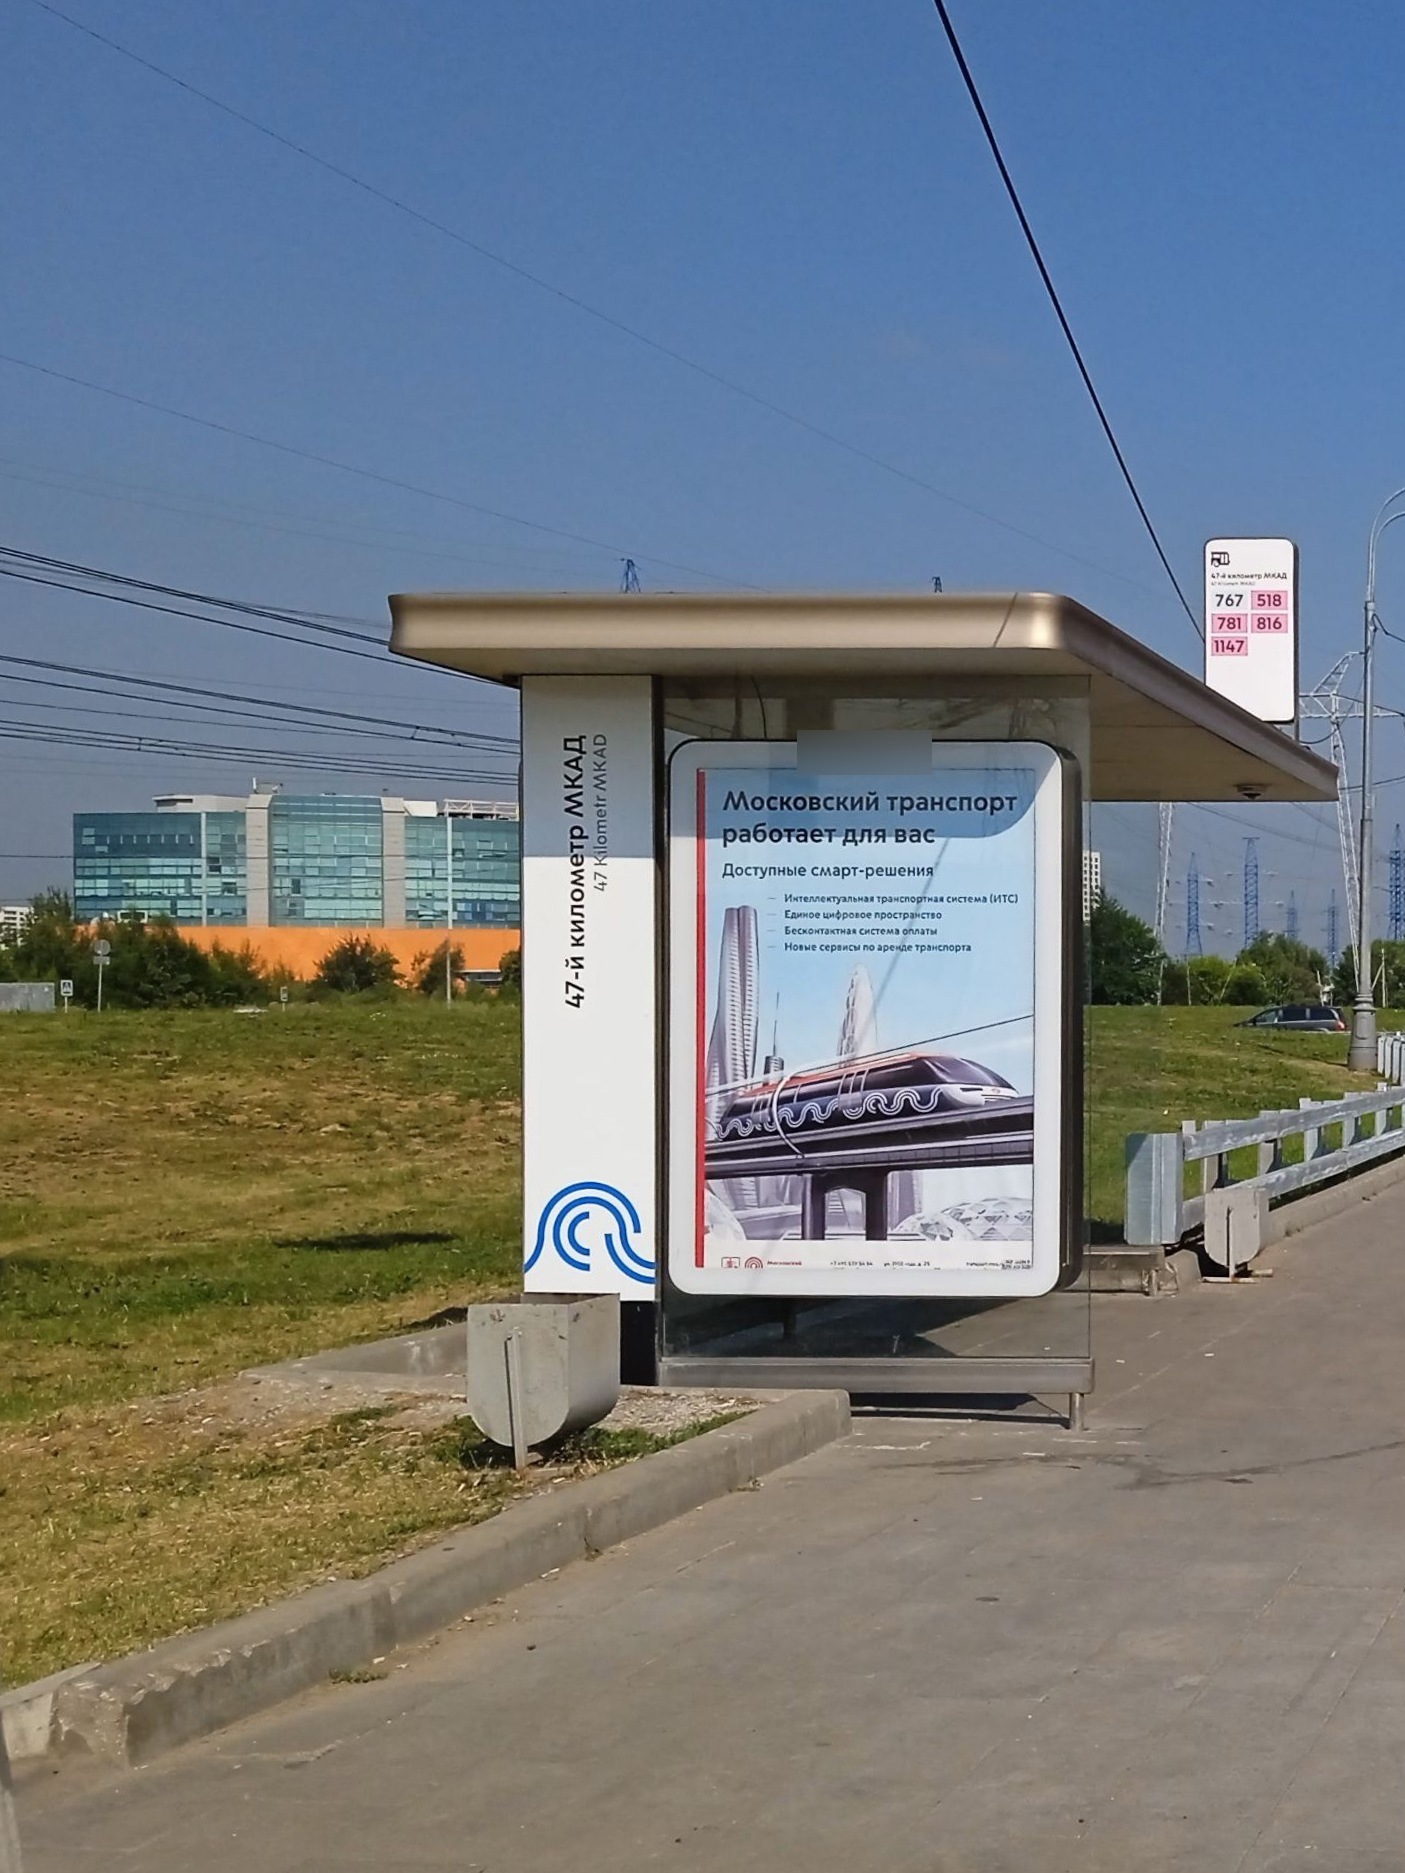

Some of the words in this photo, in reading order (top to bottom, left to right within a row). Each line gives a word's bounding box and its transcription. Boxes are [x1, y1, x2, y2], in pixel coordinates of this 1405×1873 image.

[1263, 572, 1288, 580] МКАД
[1215, 594, 1244, 607] 767
[1257, 594, 1282, 607] 518
[1217, 617, 1242, 630] 781
[1257, 617, 1282, 630] 816
[1214, 640, 1245, 653] 1147
[593, 734, 607, 791] MKAD
[563, 735, 586, 818] МКАД
[722, 791, 879, 811] Московский
[887, 795, 1017, 815] транспорт
[593, 796, 607, 866] Kilometr
[722, 823, 836, 847] работает
[842, 827, 887, 846] для
[894, 827, 936, 843] вас
[722, 863, 807, 879] Доступные
[811, 864, 934, 878] смарт-решения
[569, 825, 588, 947] километр
[593, 872, 607, 891] 47
[784, 894, 875, 905] Интеллектуальная
[876, 895, 945, 905] транспортная
[947, 896, 988, 904] система
[989, 893, 1019, 905] (ИТС)
[784, 909, 821, 920] Единое
[822, 910, 872, 922] цифровое
[874, 911, 943, 921] пространство
[784, 925, 857, 936] Бесконтактная
[859, 927, 900, 936] система
[902, 927, 938, 936] оплаты
[784, 942, 818, 952] Новые
[819, 943, 861, 952] сервисы
[862, 943, 876, 952] по
[877, 943, 913, 953] аренде
[914, 943, 972, 953] транспорта
[565, 957, 585, 1008] 47-й
